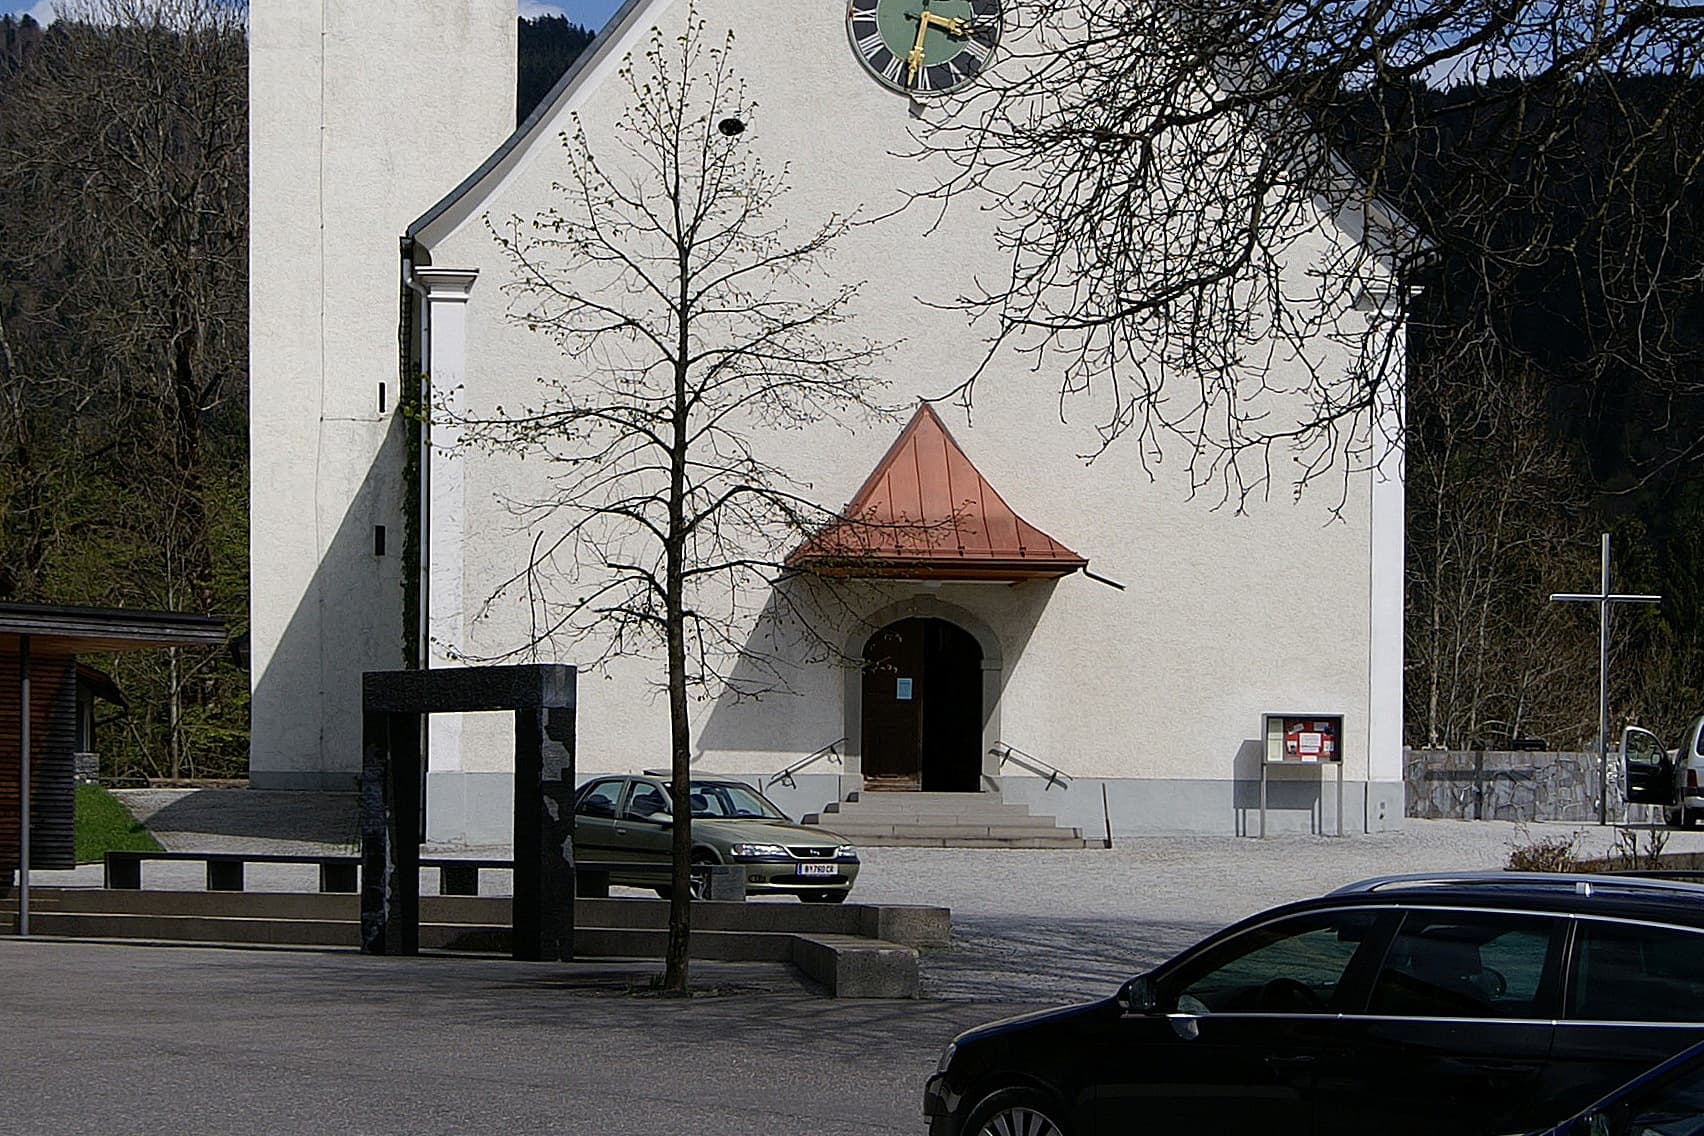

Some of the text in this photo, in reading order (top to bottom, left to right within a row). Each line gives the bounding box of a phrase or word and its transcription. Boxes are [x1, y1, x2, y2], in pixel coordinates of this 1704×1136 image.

[852, 8, 877, 22] IX
[858, 33, 885, 60] VIII
[882, 56, 903, 83] VII
[917, 67, 932, 91] VI
